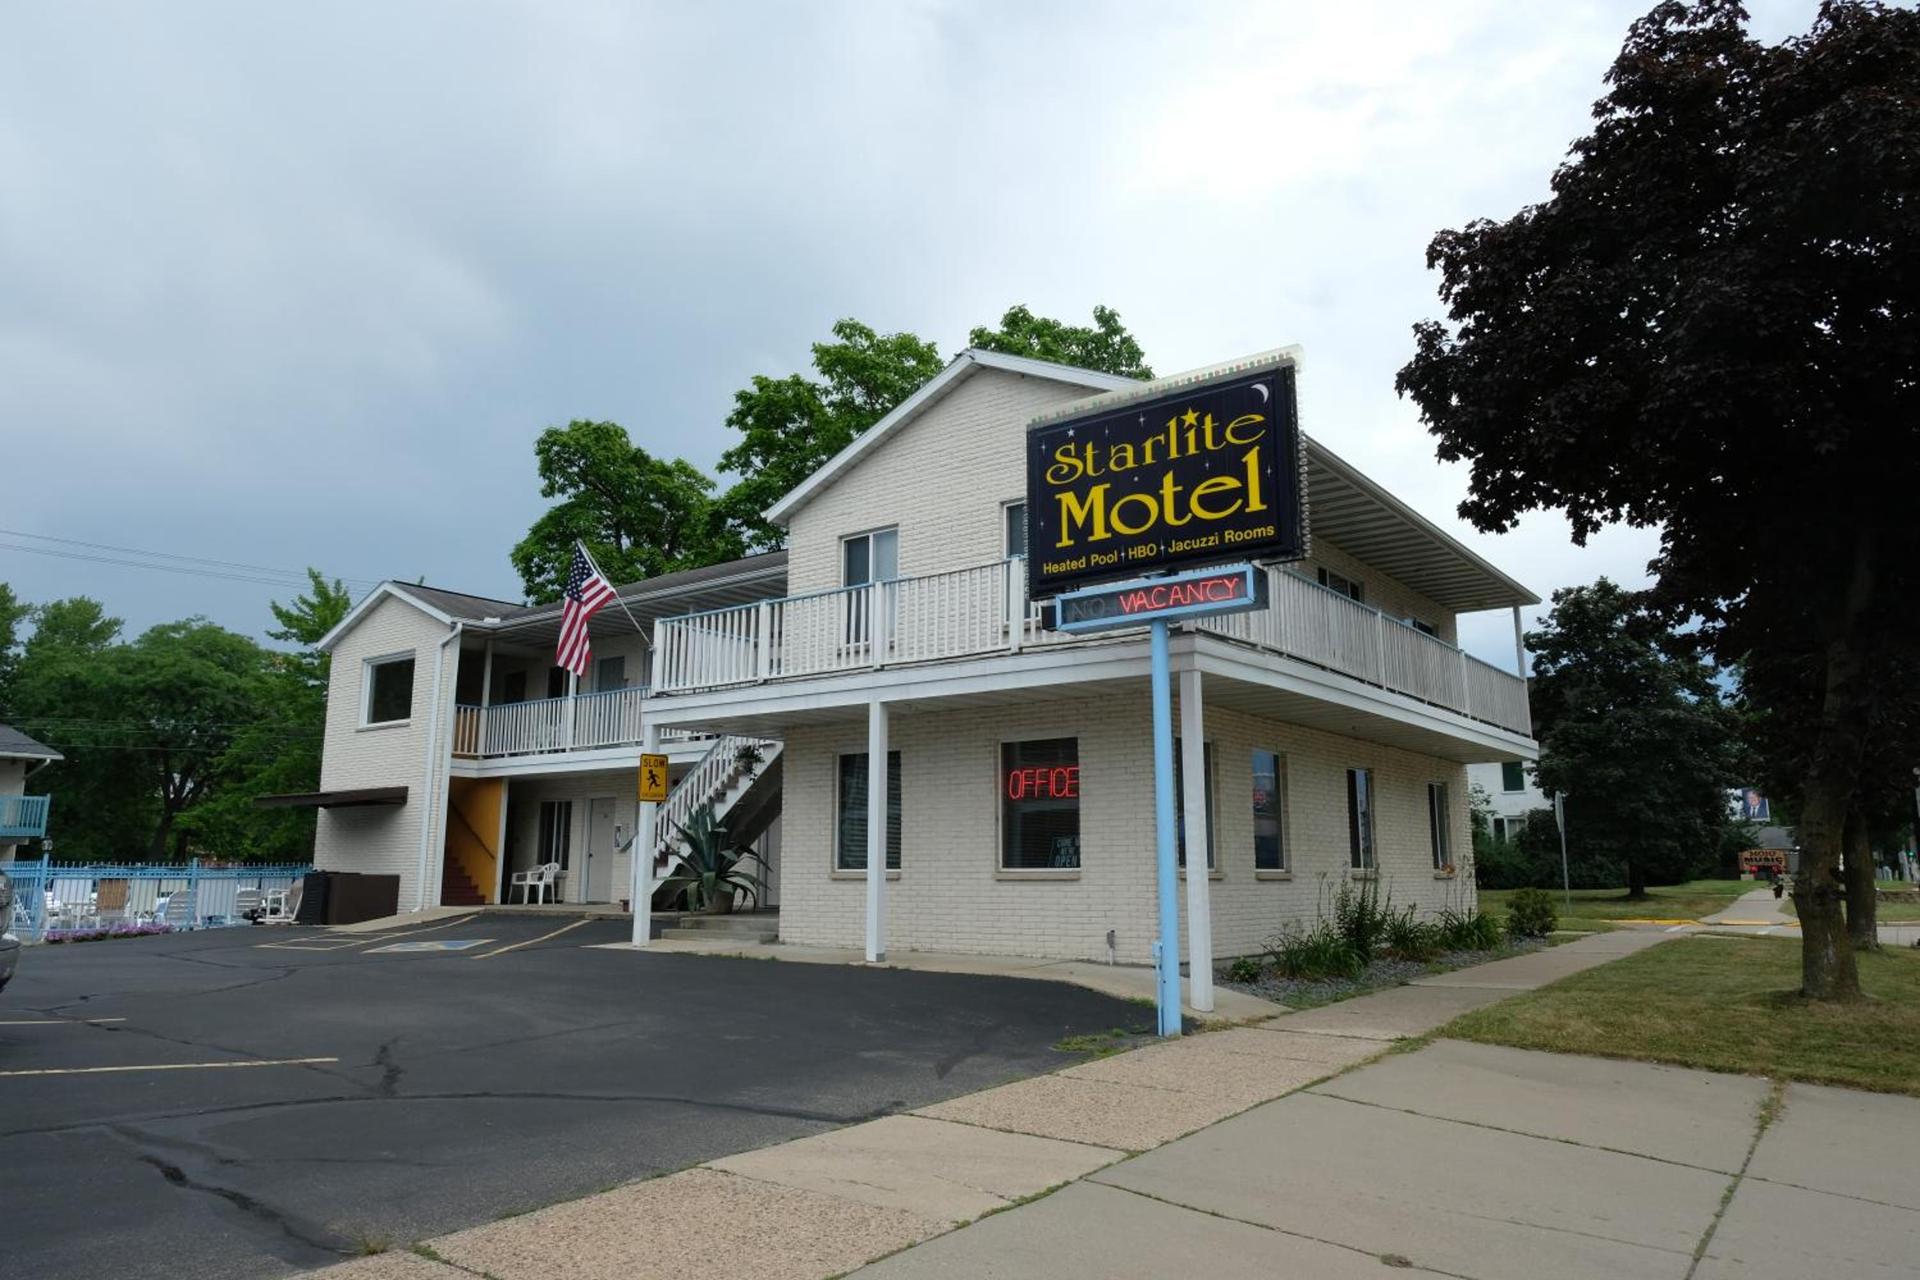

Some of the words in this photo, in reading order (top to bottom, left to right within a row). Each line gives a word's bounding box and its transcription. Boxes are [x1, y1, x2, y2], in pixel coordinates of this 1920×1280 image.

[1046, 408, 1266, 485] Starlite
[1055, 445, 1268, 548] Motel
[1043, 558, 1086, 575] Heated
[1091, 551, 1118, 567] Pool
[1128, 543, 1157, 560] HBO
[1168, 532, 1219, 553] Jacuzzi
[1224, 524, 1275, 543] Rooms
[1119, 577, 1239, 613] VACANCY
[643, 758, 665, 768] SLOW
[1009, 766, 1080, 799] OFFICE
